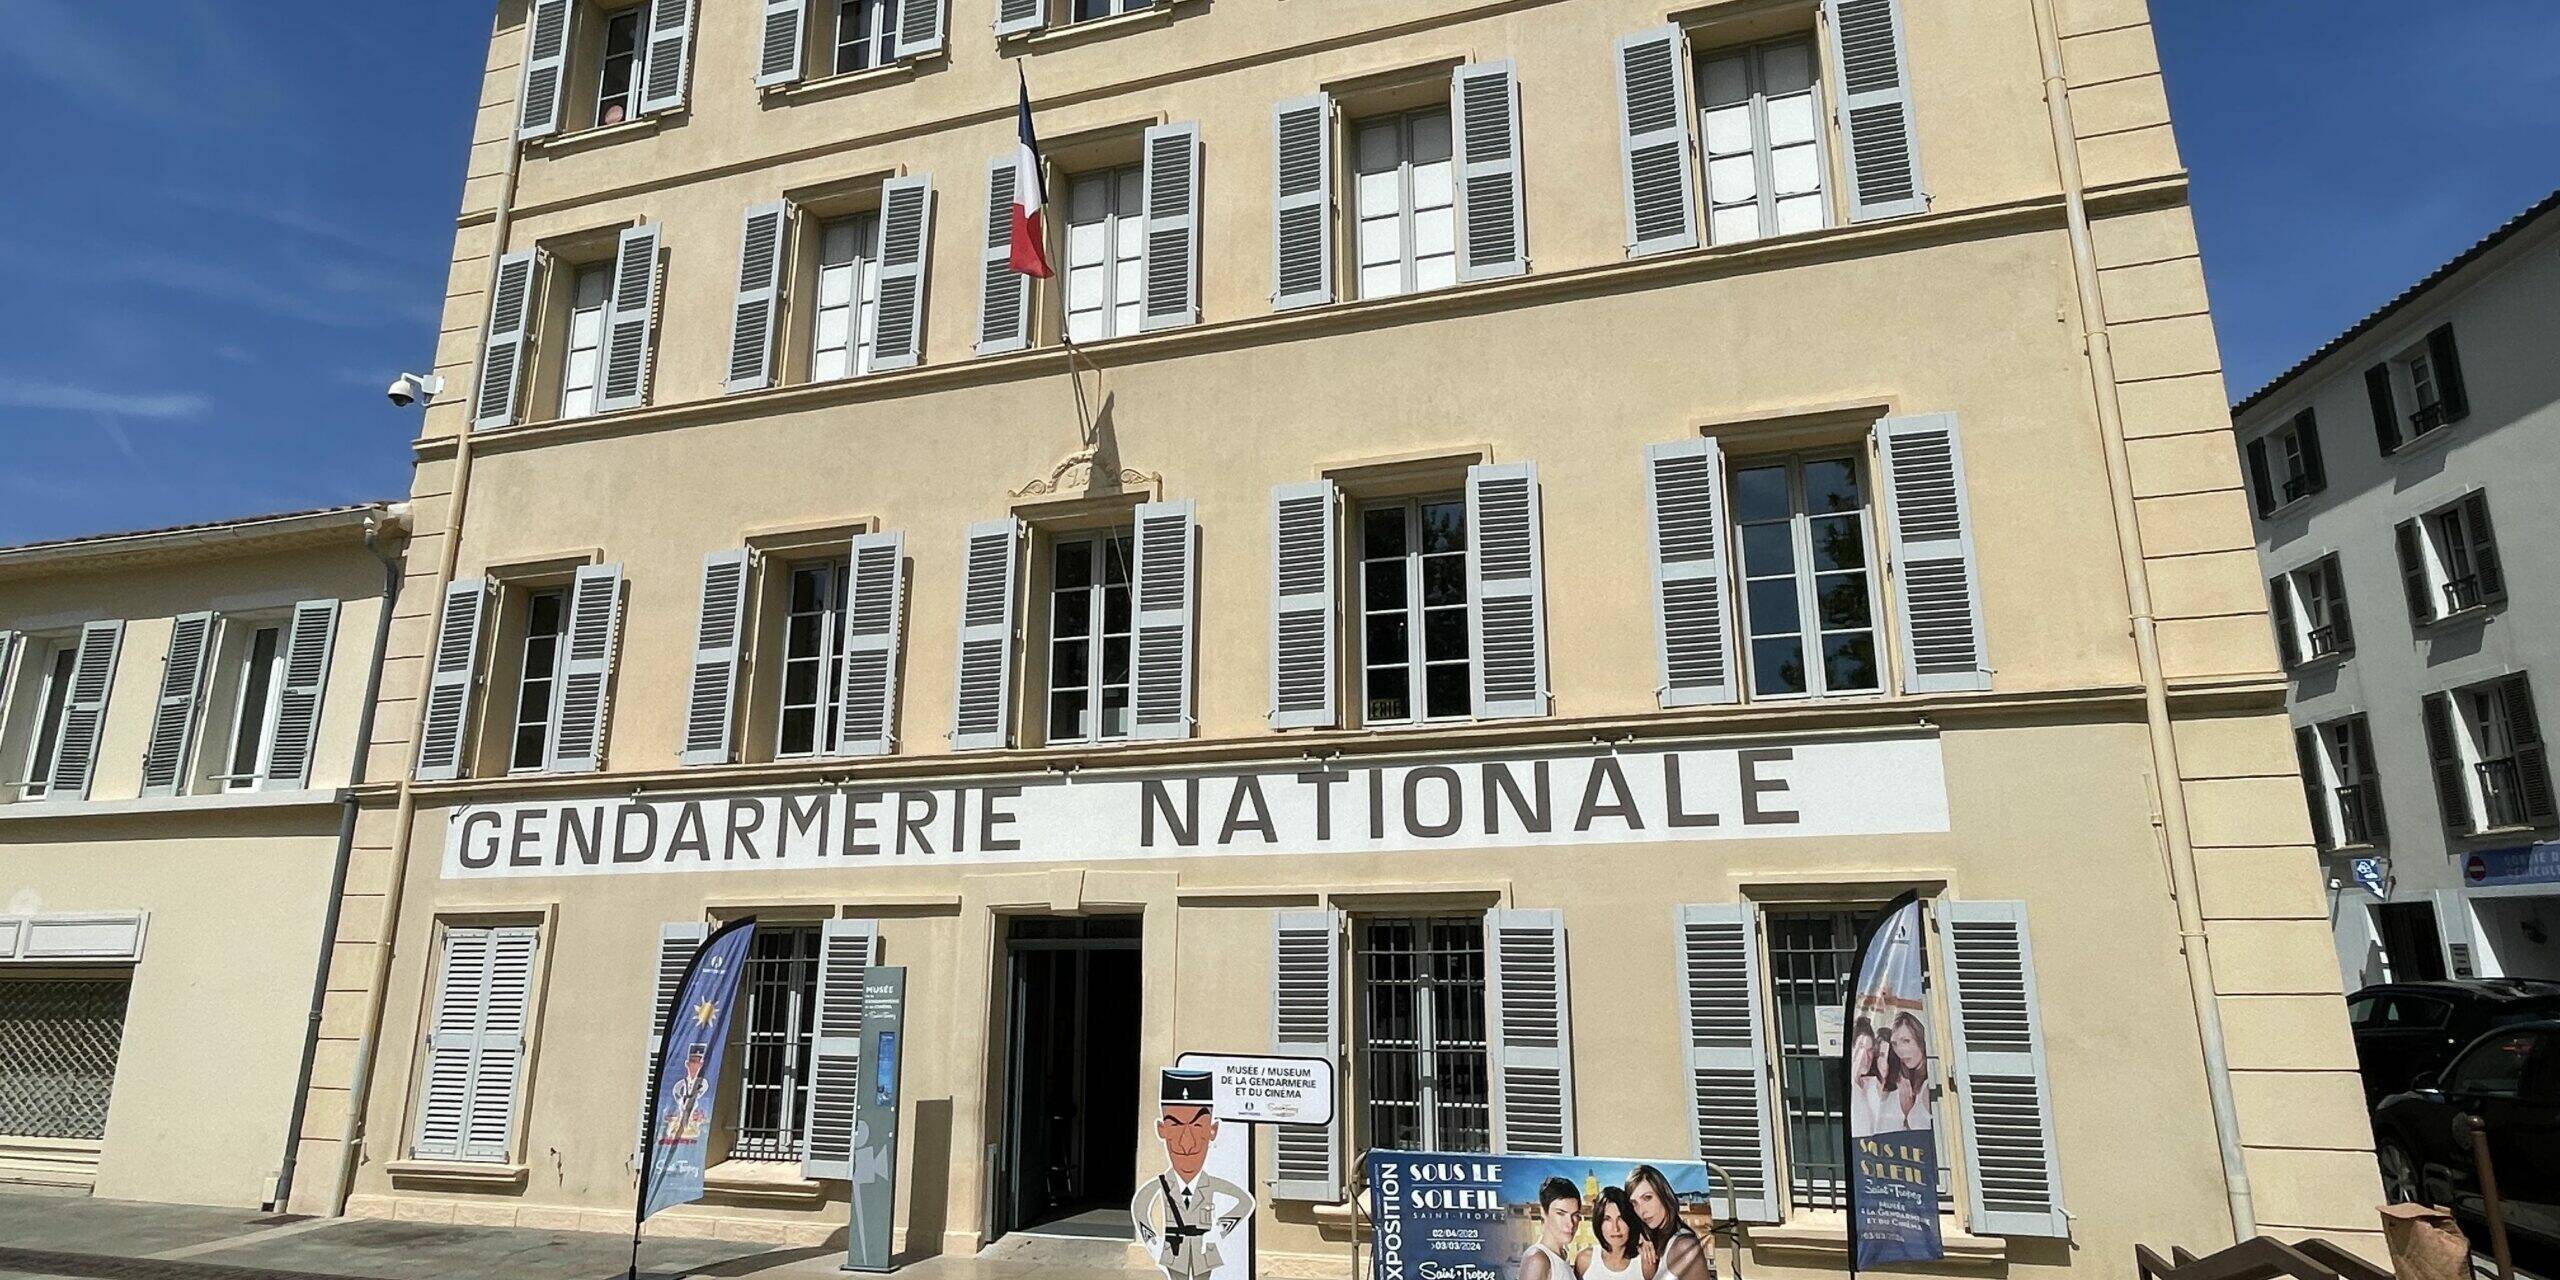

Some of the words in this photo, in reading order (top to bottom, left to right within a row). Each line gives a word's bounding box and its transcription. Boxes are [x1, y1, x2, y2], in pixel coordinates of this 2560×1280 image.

[459, 785, 1023, 870] GENDARMERIE
[1140, 747, 1801, 847] NATIONALE
[1221, 1075, 1233, 1085] DE
[1235, 1077, 1247, 1085] LA
[1249, 1077, 1317, 1088] GENDARMERIE
[1267, 1068, 1311, 1077] MUSEUM
[1235, 1087, 1246, 1096] ET
[1248, 1088, 1262, 1096] DU
[1900, 1145, 1926, 1164] LE
[1409, 1163, 1466, 1181] SOUS
[1472, 1163, 1503, 1182] LE
[1860, 1159, 1928, 1186] SLEIL
[1410, 1189, 1505, 1210] SOLEIL
[1381, 1163, 1404, 1280] XPOSITION
